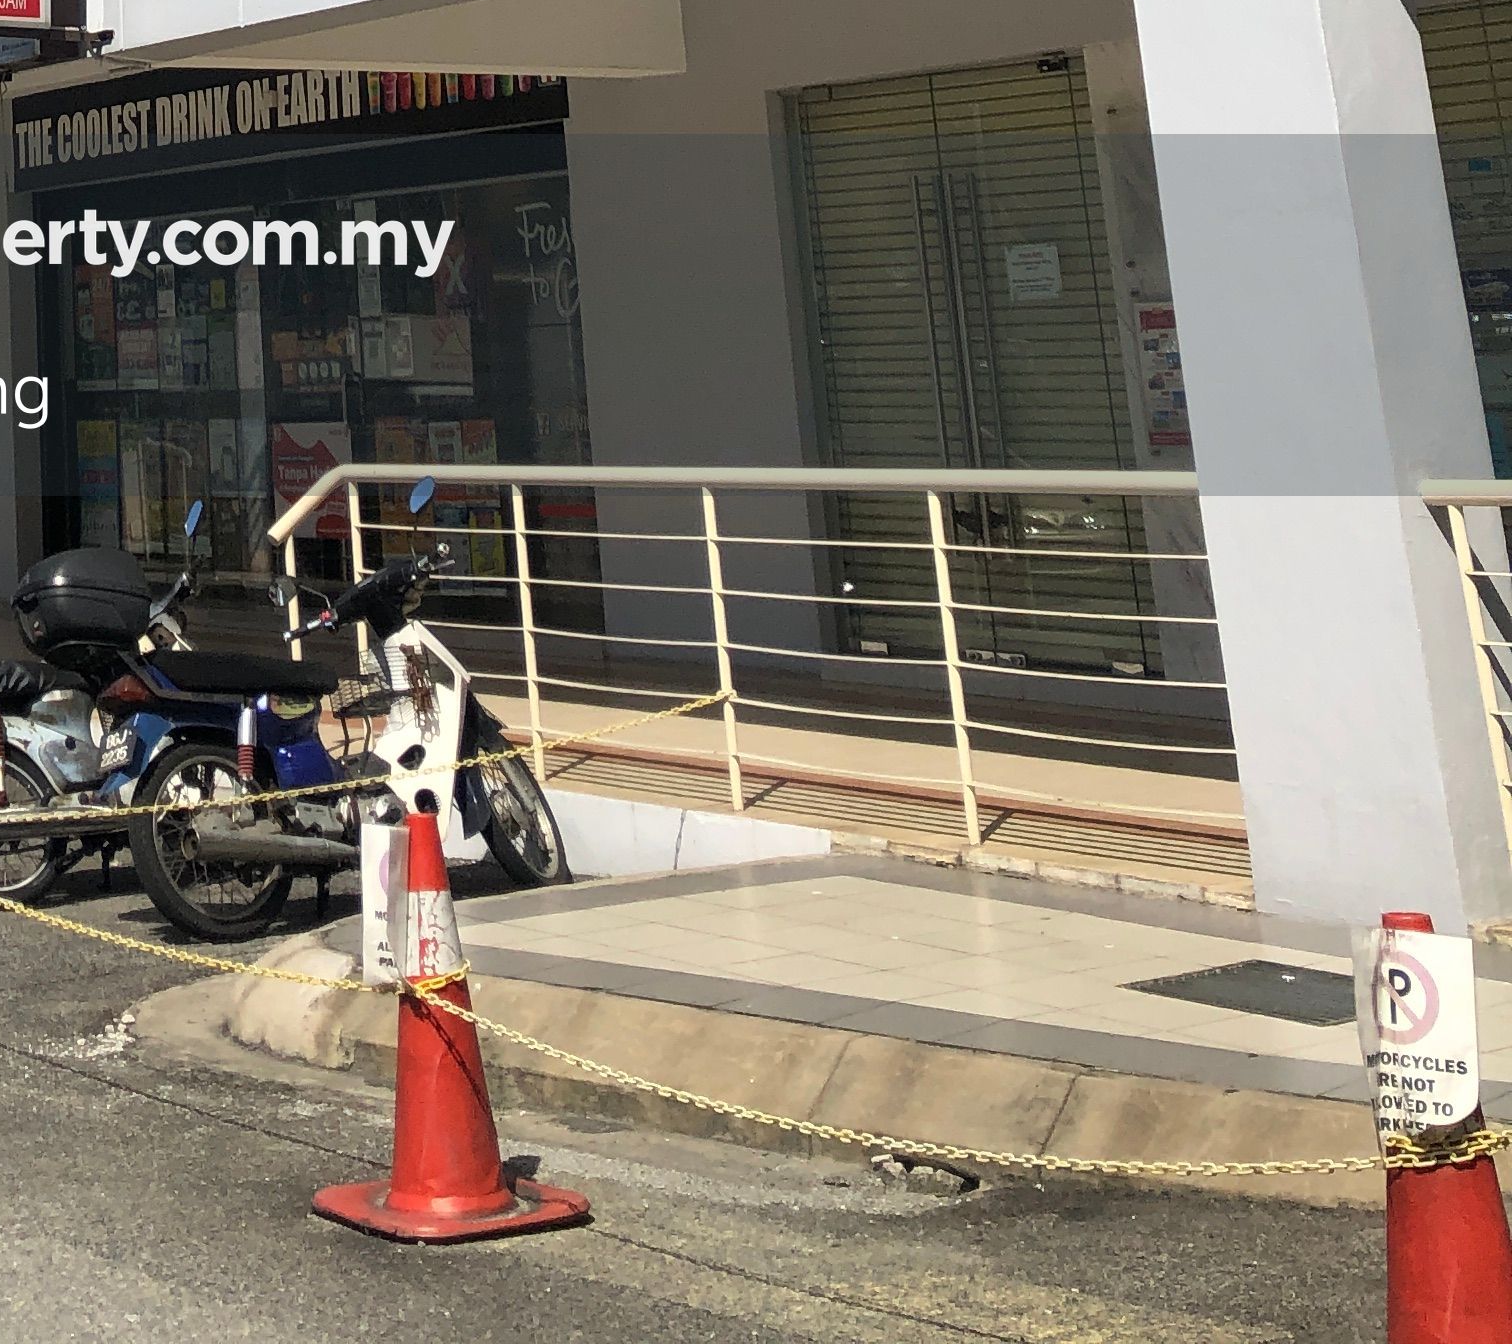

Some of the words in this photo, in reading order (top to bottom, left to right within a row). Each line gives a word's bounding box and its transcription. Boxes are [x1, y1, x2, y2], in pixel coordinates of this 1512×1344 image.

[15, 117, 53, 170] THE
[57, 101, 150, 163] COOLEST
[155, 83, 230, 147] DRINK
[276, 69, 361, 128] EARTH
[1401, 1075, 1436, 1093] NOT
[1432, 1101, 1454, 1117] TO
